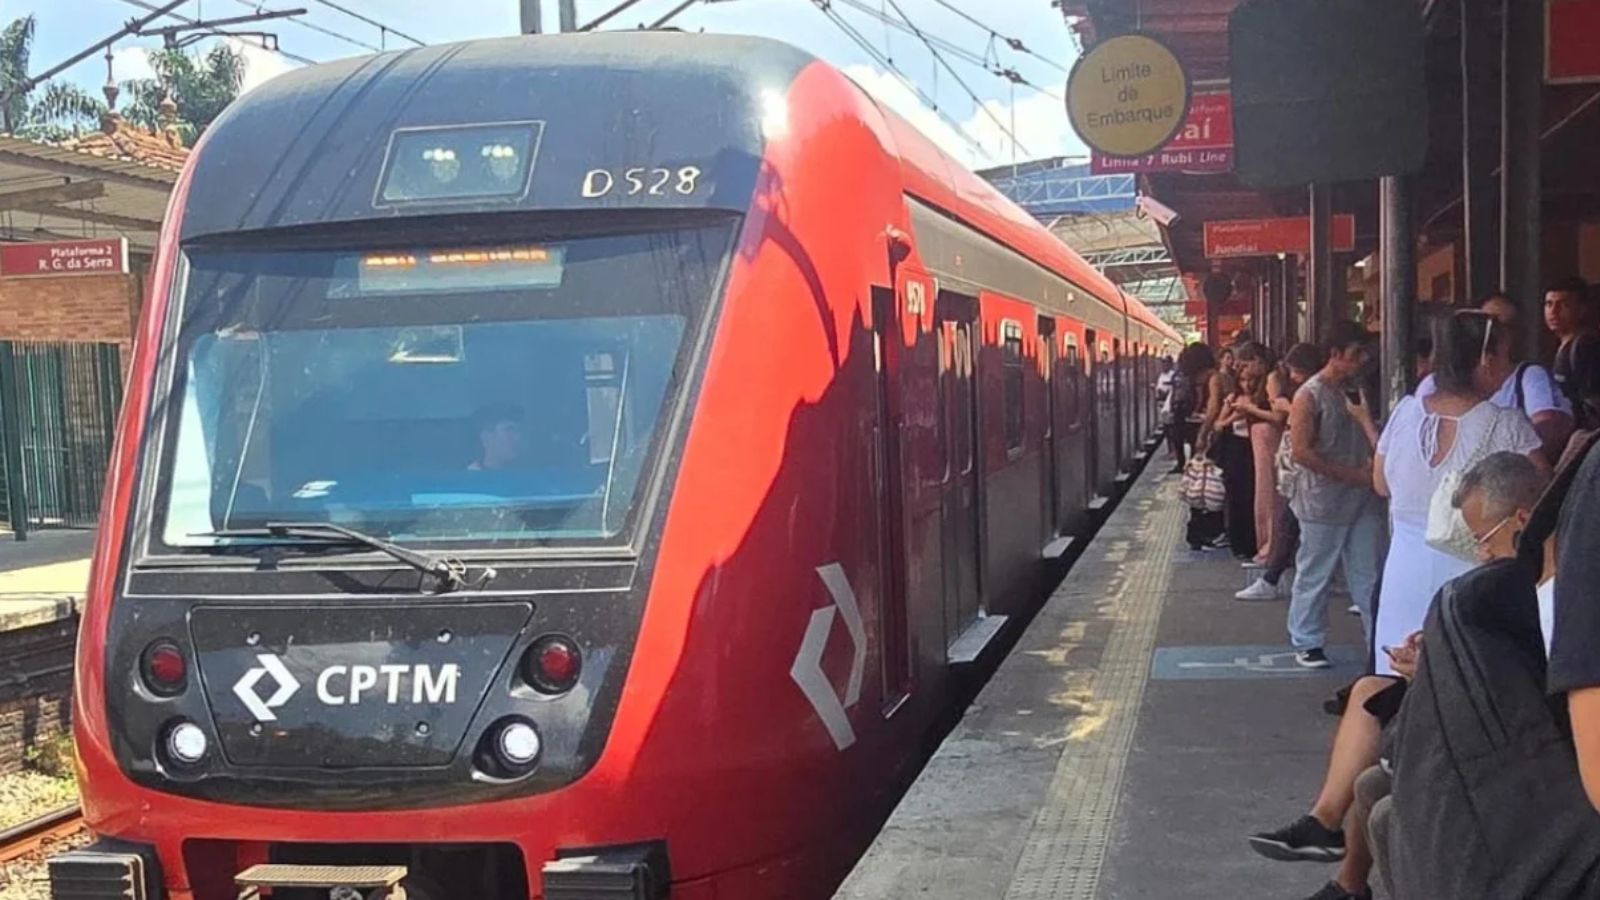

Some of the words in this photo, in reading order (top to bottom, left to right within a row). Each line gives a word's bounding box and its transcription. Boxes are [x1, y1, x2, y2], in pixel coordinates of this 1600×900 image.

[1101, 63, 1151, 83] Limite
[1118, 86, 1138, 102] de
[1086, 104, 1174, 128] Embarque
[1161, 153, 1192, 165] Rubi
[1200, 152, 1226, 163] Line
[51, 247, 104, 258] Plataforma
[106, 245, 113, 255] 2
[38, 260, 48, 270] R.
[52, 258, 65, 270] G.
[67, 257, 81, 269] da
[84, 257, 114, 269] Serra
[316, 663, 458, 705] CPTM
